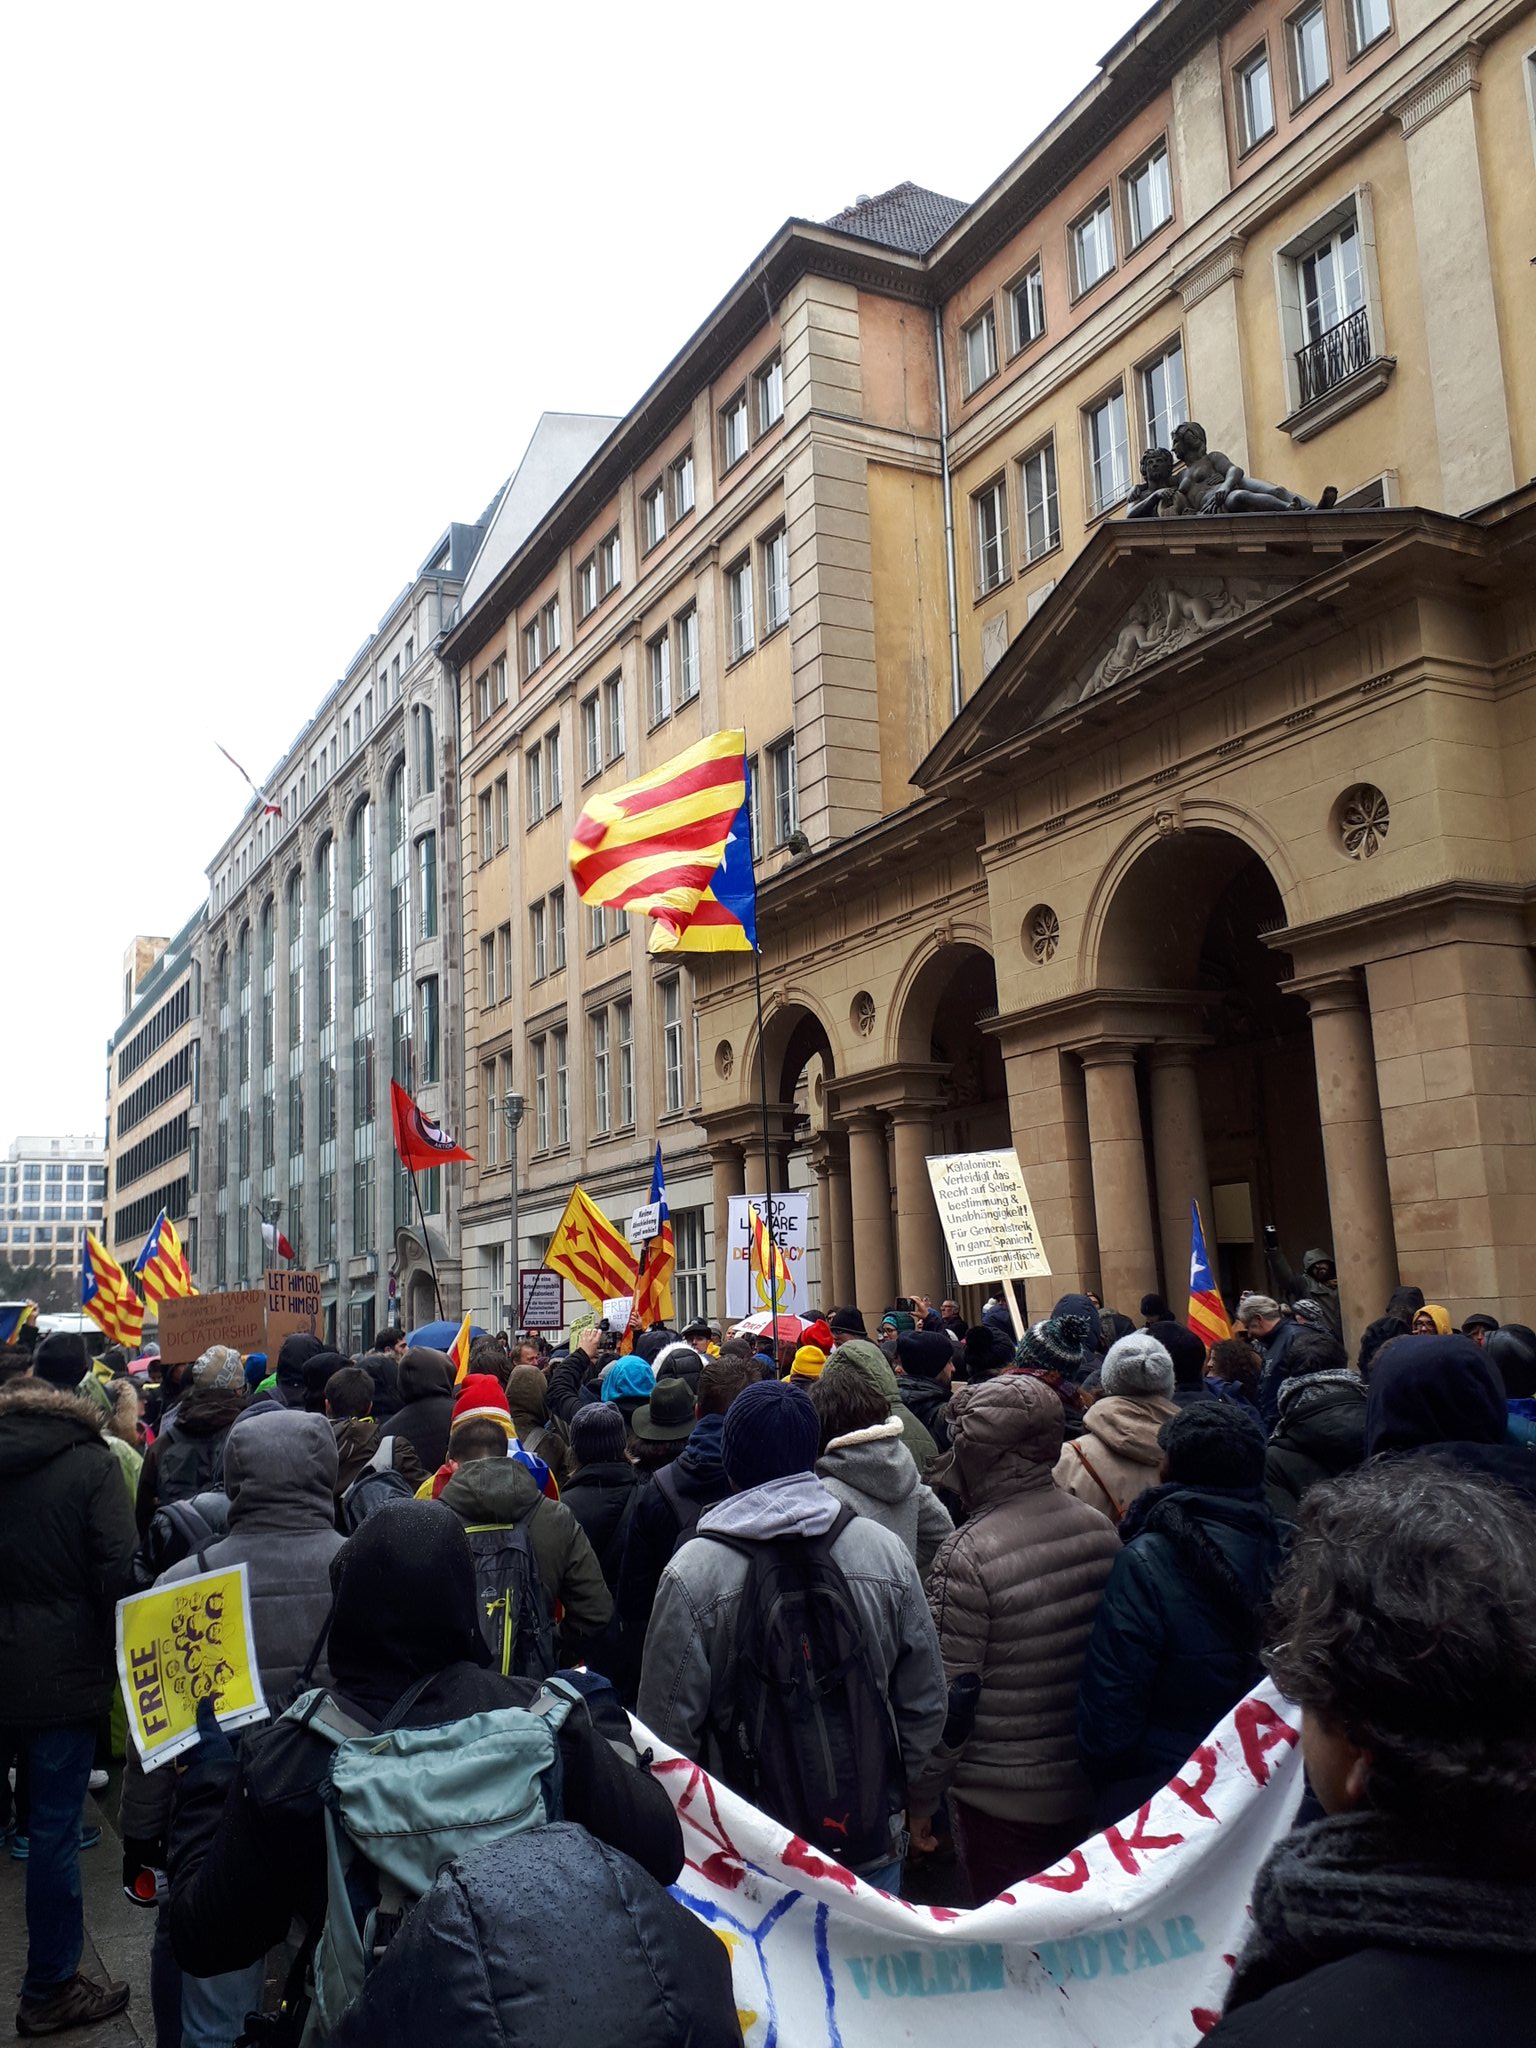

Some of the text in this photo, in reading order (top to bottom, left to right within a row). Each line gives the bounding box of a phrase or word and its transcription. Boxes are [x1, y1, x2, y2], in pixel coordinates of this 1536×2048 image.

[945, 1159, 1001, 1174] Katalonien:
[943, 1170, 1010, 1186] Verteidigt das
[938, 1182, 1022, 1200] Recht auf Selbst-
[752, 1200, 786, 1216] STOP
[948, 1194, 1019, 1211] bestimmung &
[946, 1204, 1028, 1224] Unabhängigkeit!
[950, 1221, 1033, 1240] Für Generalstreik
[955, 1232, 1034, 1252] in ganz Spanien!
[958, 1251, 1040, 1268] Internationalistische
[268, 1273, 320, 1295] LET HIM GO,
[221, 1291, 260, 1306] MADRID
[269, 1294, 319, 1315] LET HIM GO
[166, 1323, 258, 1346] DICTATORSHIP
[131, 1641, 168, 1737] FREE
[845, 1942, 1006, 2000] VOLEM
